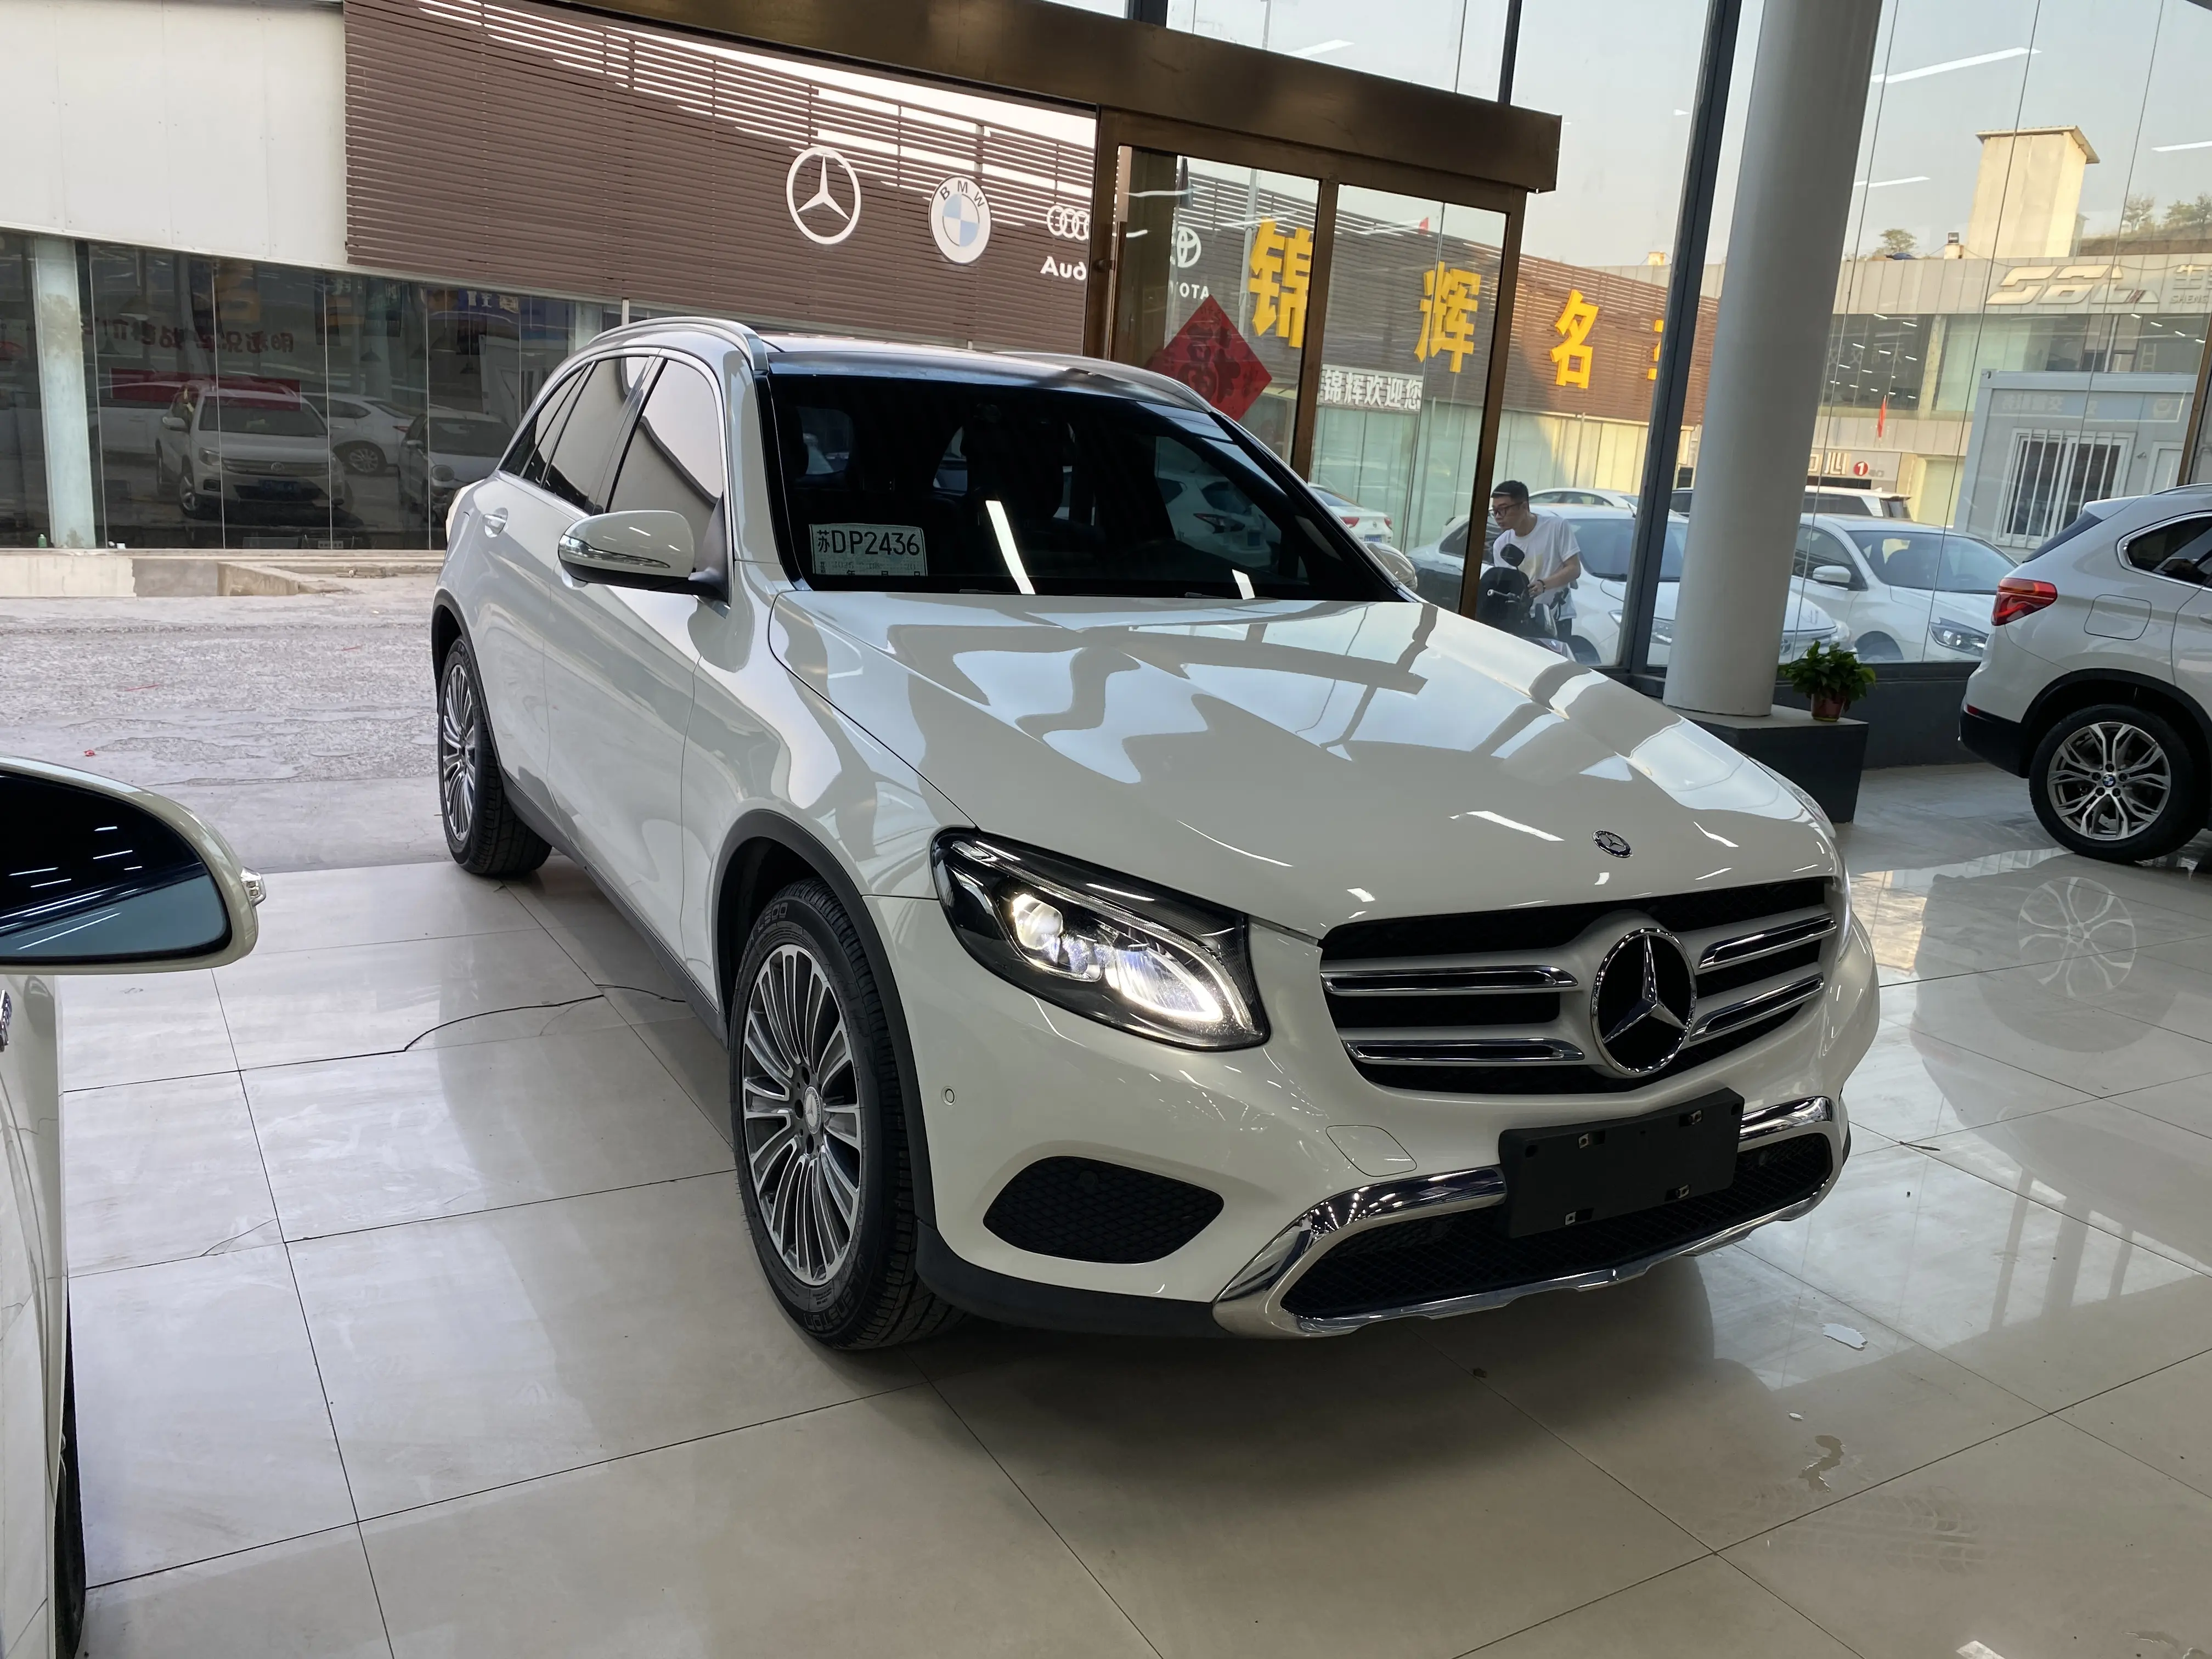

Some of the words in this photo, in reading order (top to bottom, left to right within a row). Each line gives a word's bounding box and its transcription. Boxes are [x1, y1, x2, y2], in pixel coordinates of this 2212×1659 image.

[939, 180, 985, 207] BMW
[1040, 255, 1087, 280] Aud
[2173, 264, 2212, 289] 生
[1176, 281, 1210, 300] OTA
[1324, 369, 1423, 409] 锦辉欢迎您
[817, 530, 920, 556] 苏DP2436
